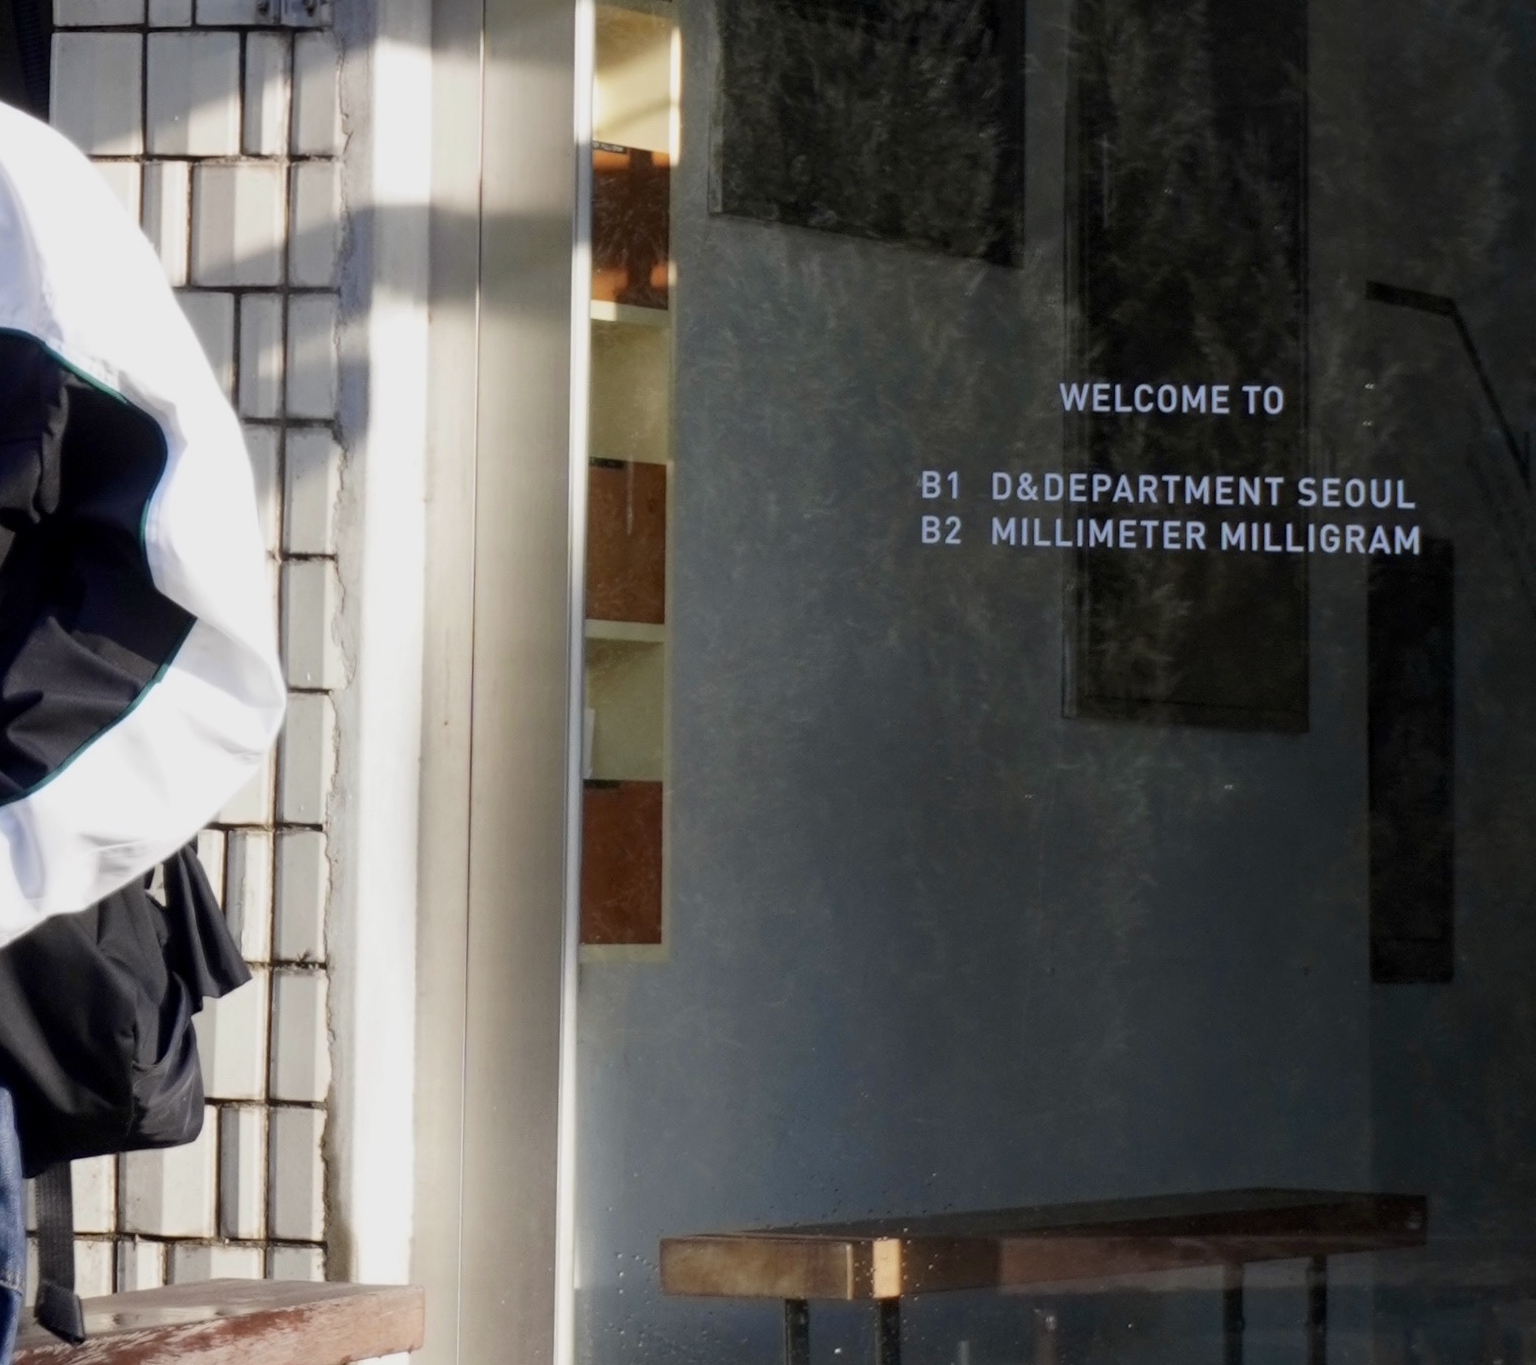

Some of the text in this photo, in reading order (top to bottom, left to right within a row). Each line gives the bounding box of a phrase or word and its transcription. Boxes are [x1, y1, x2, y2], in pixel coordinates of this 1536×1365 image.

[1059, 382, 1285, 416] WELCOME TO
[920, 470, 1417, 510] B1 D&DEPARTMENT SEOUL
[920, 515, 1421, 556] B2 MILLIMETER MILLIGRAM
